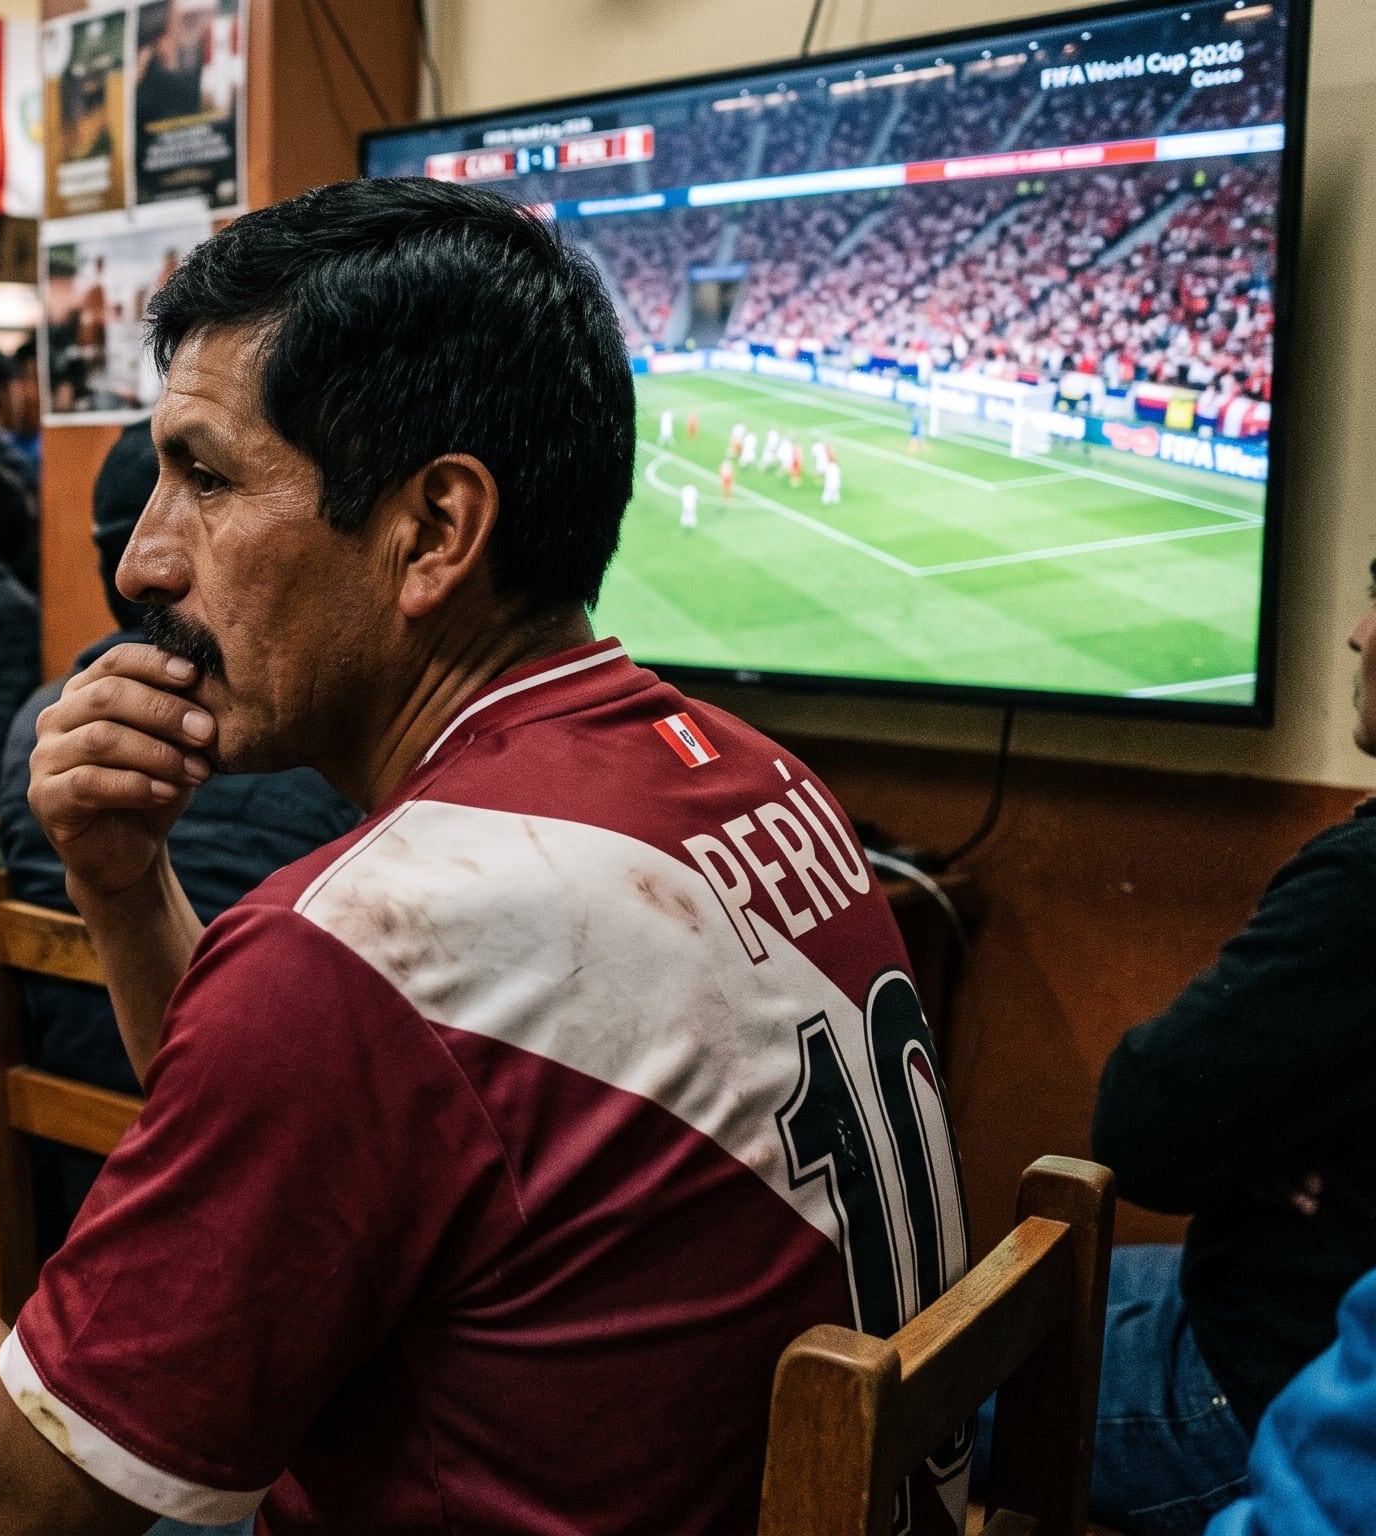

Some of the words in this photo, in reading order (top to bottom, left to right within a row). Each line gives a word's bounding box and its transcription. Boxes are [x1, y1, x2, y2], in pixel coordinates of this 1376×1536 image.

[1040, 64, 1086, 90] FIFA
[1084, 54, 1145, 83] World
[1146, 52, 1188, 75] Cup
[1189, 39, 1245, 68] 2026
[1190, 67, 1245, 88] Cusco
[1159, 432, 1213, 469] FIFA
[682, 758, 871, 965] PERÚ
[774, 966, 977, 1536] 10
